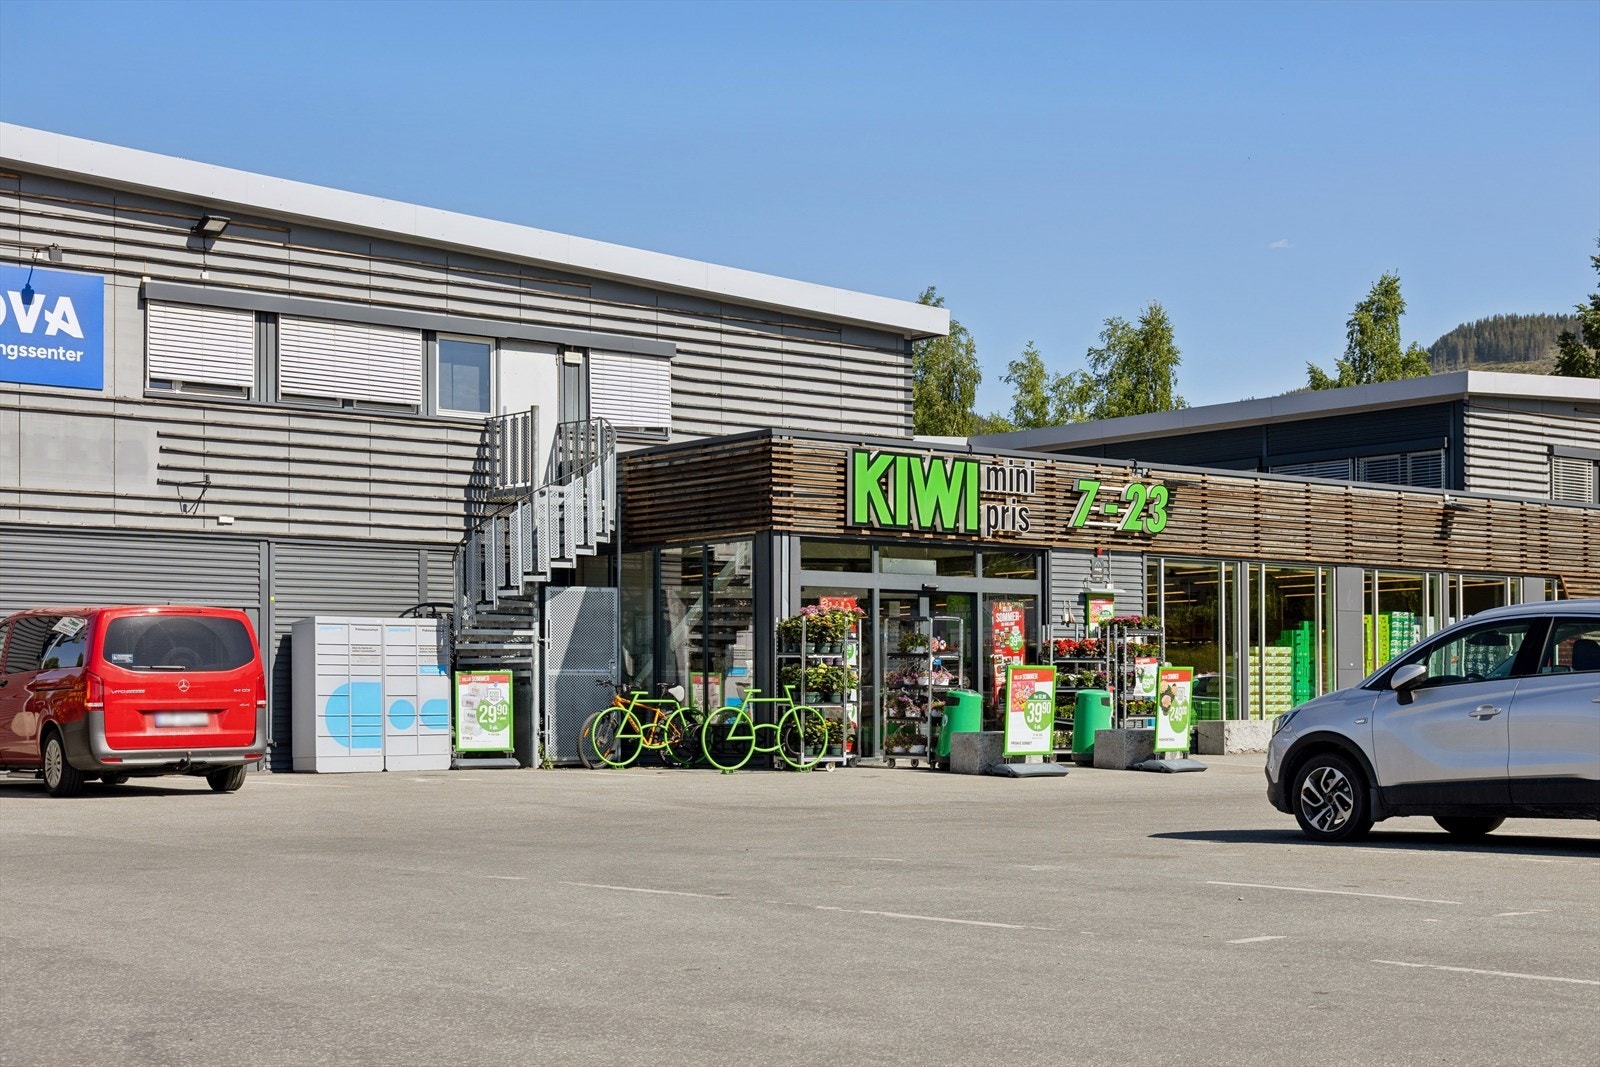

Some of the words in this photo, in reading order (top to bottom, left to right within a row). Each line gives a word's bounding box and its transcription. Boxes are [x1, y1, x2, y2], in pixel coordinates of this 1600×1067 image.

[0, 290, 84, 338] VA
[852, 448, 981, 534] KIWI
[985, 458, 1036, 495] mini
[985, 497, 1031, 537] pris
